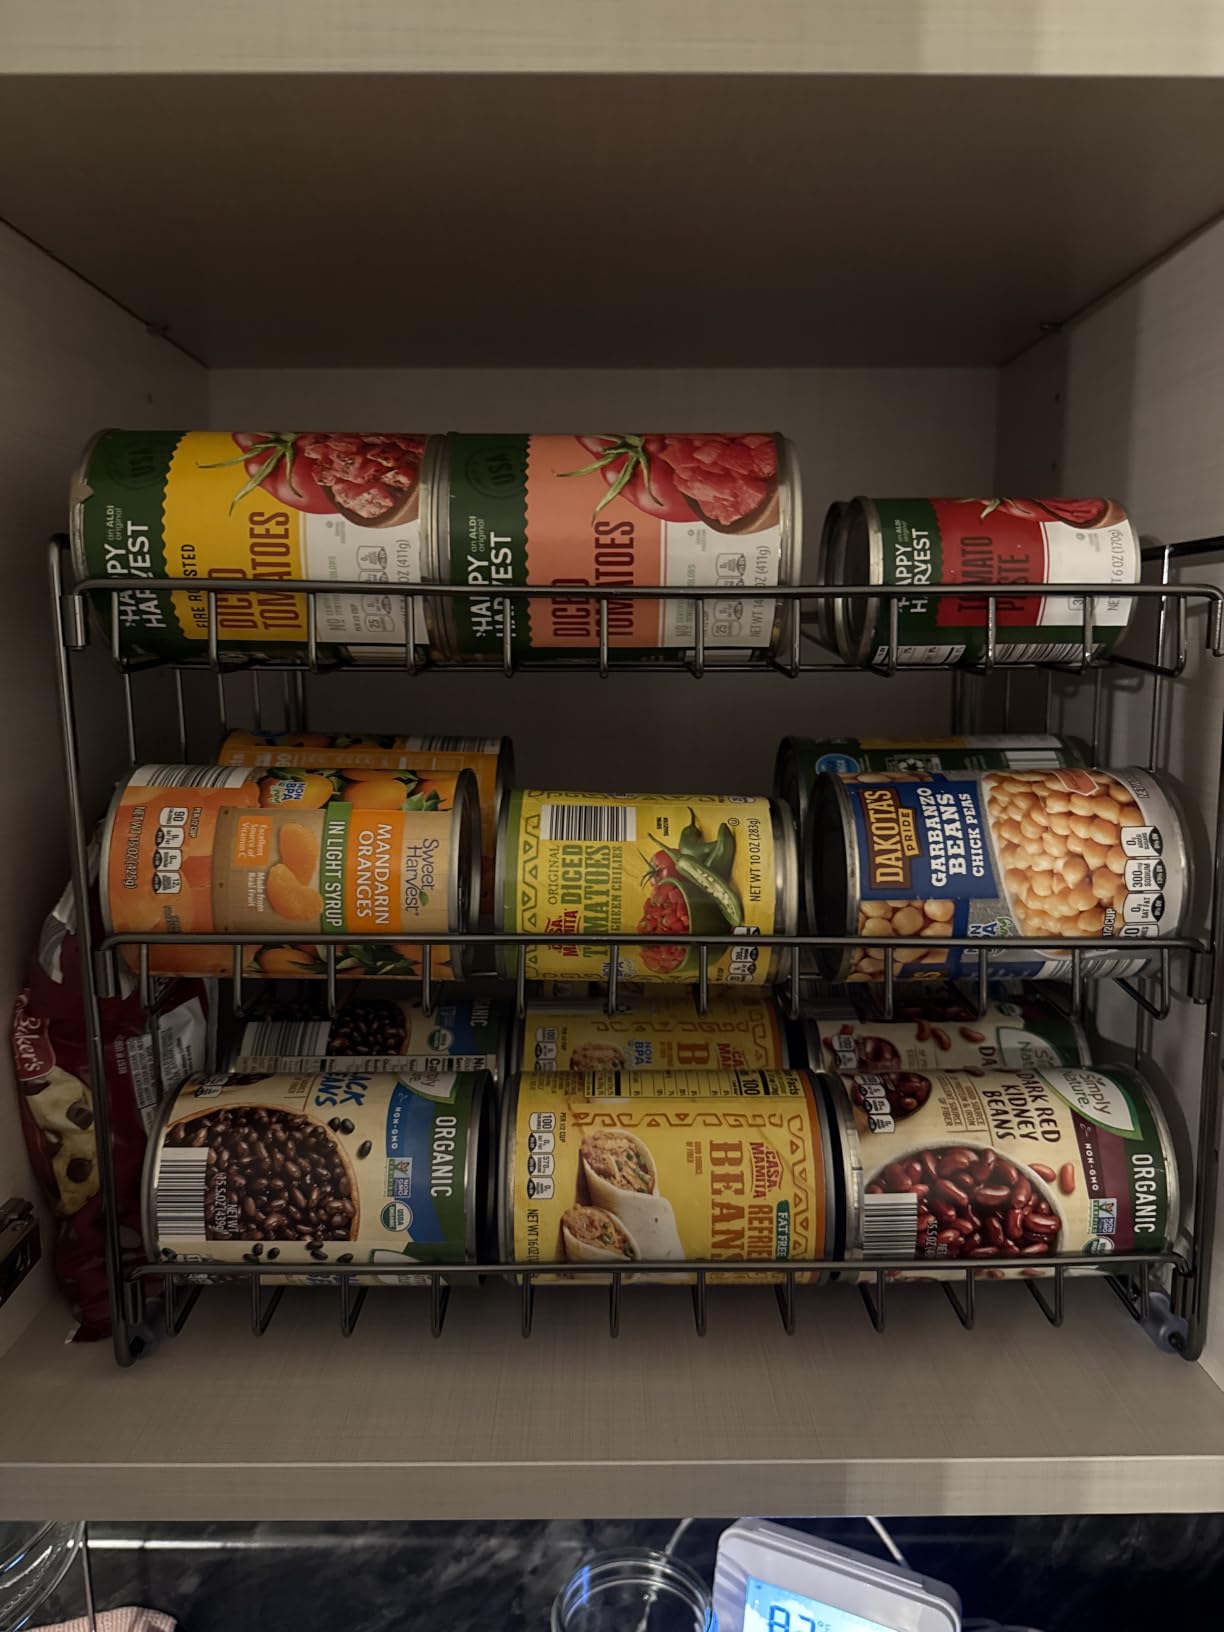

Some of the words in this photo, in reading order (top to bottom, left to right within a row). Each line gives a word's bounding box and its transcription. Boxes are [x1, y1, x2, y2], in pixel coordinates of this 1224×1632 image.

[486, 453, 515, 487] USA
[106, 505, 114, 528] ALDI
[115, 508, 124, 540] original
[468, 516, 477, 539] ALDI
[470, 541, 478, 552] an
[478, 519, 486, 552] original
[1108, 529, 1124, 554] (170g)
[181, 544, 201, 602] RSTED
[249, 511, 302, 630] TOMATOES
[912, 528, 932, 613] HRVEST
[957, 536, 993, 612] TMATO
[1112, 556, 1124, 568] OZ
[104, 543, 140, 622] HAPY
[997, 554, 1029, 612] PSTE
[208, 568, 259, 629] DICD
[188, 608, 208, 629] FIRE
[282, 782, 295, 801] BPA
[294, 783, 306, 800] NON
[132, 806, 146, 820] NET
[173, 810, 185, 822] 90
[959, 793, 979, 825] PEAS
[130, 821, 142, 835] WT
[240, 822, 250, 850] Vitamin
[256, 824, 268, 856] Excellent
[328, 821, 346, 834] IN
[747, 818, 761, 841] (283g)
[863, 790, 904, 883] DAKOTA'S
[901, 810, 916, 852] PRIDE
[916, 787, 947, 887] GARBANZO
[936, 793, 967, 875] BEANS
[127, 846, 139, 860] OZ
[128, 836, 140, 846] 15
[750, 842, 760, 854] OZ
[968, 828, 985, 877] CHICK
[325, 840, 342, 878] LIGHT
[421, 839, 440, 890] Sweet
[750, 855, 760, 865] 10
[124, 860, 138, 889] (425g)
[248, 872, 256, 888] Real
[256, 872, 266, 893] Made
[356, 830, 374, 918] ORANGES
[375, 824, 392, 924] MANDARIN
[405, 846, 422, 912] Harvest
[548, 845, 560, 905] ORIGINAL
[562, 844, 582, 905] DICED
[750, 868, 760, 883] WT
[1144, 863, 1152, 887] SODIUM
[248, 889, 256, 907] Fruit
[256, 894, 265, 912] from
[325, 882, 342, 927] SYRUP
[583, 845, 611, 958] TMATOES
[750, 885, 761, 902] NET
[1143, 897, 1151, 908] FAT
[1104, 908, 1117, 926] CUP
[1142, 909, 1150, 919] SAT
[15, 1016, 44, 1072] Baker's
[634, 1041, 644, 1065] BPA
[743, 1079, 761, 1095] 100
[787, 1078, 800, 1096] Facts
[1079, 1073, 1112, 1115] Simply
[982, 1090, 1016, 1140] BEANS
[1001, 1084, 1038, 1142] KIDNEY
[1016, 1071, 1048, 1102] DARK
[1035, 1106, 1062, 1143] RED
[391, 1106, 402, 1150] NON-GMO
[542, 1114, 553, 1130] 100
[430, 1116, 457, 1198] ORGANIC
[765, 1151, 780, 1188] CASA
[1084, 1142, 1100, 1192] NON-GMO
[750, 1142, 767, 1199] MAMITA
[214, 1194, 226, 1206] OZ
[1131, 1153, 1157, 1234] ORGANIC
[228, 1204, 240, 1219] NET
[526, 1208, 540, 1223] NET
[777, 1212, 789, 1234] FAT
[227, 1219, 240, 1232] WT
[527, 1225, 540, 1236] WT
[747, 1204, 774, 1258] REFRIE
[528, 1238, 538, 1246] 16
[528, 1247, 538, 1256] OZ
[776, 1235, 787, 1257] FREE
[926, 1236, 937, 1246] OZ
